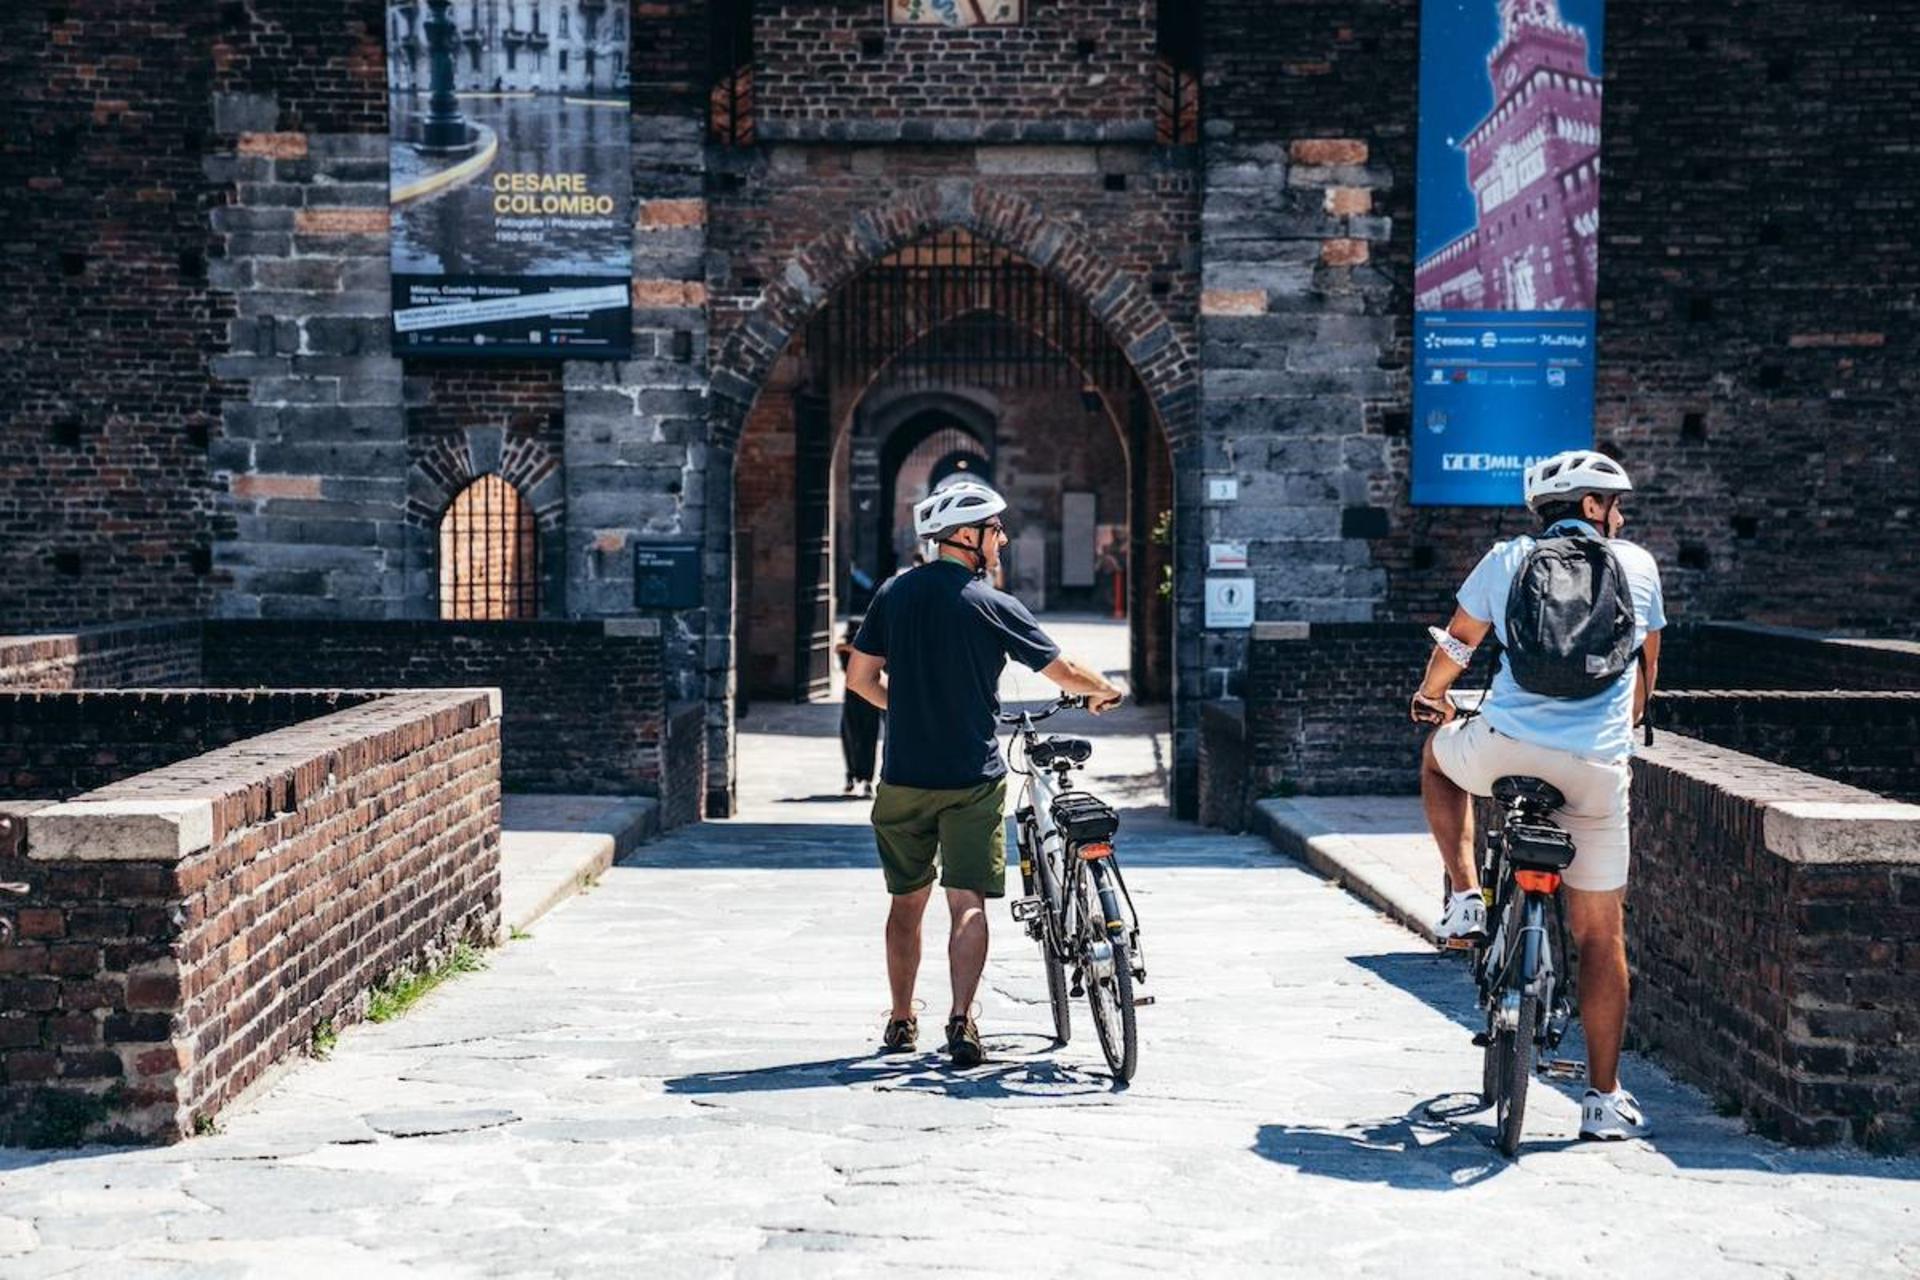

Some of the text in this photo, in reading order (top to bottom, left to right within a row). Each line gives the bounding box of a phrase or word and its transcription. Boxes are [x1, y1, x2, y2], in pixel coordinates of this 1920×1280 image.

[494, 173, 587, 192] CESARE
[494, 194, 614, 214] COLOMBO
[1583, 1105, 1603, 1122] IR
